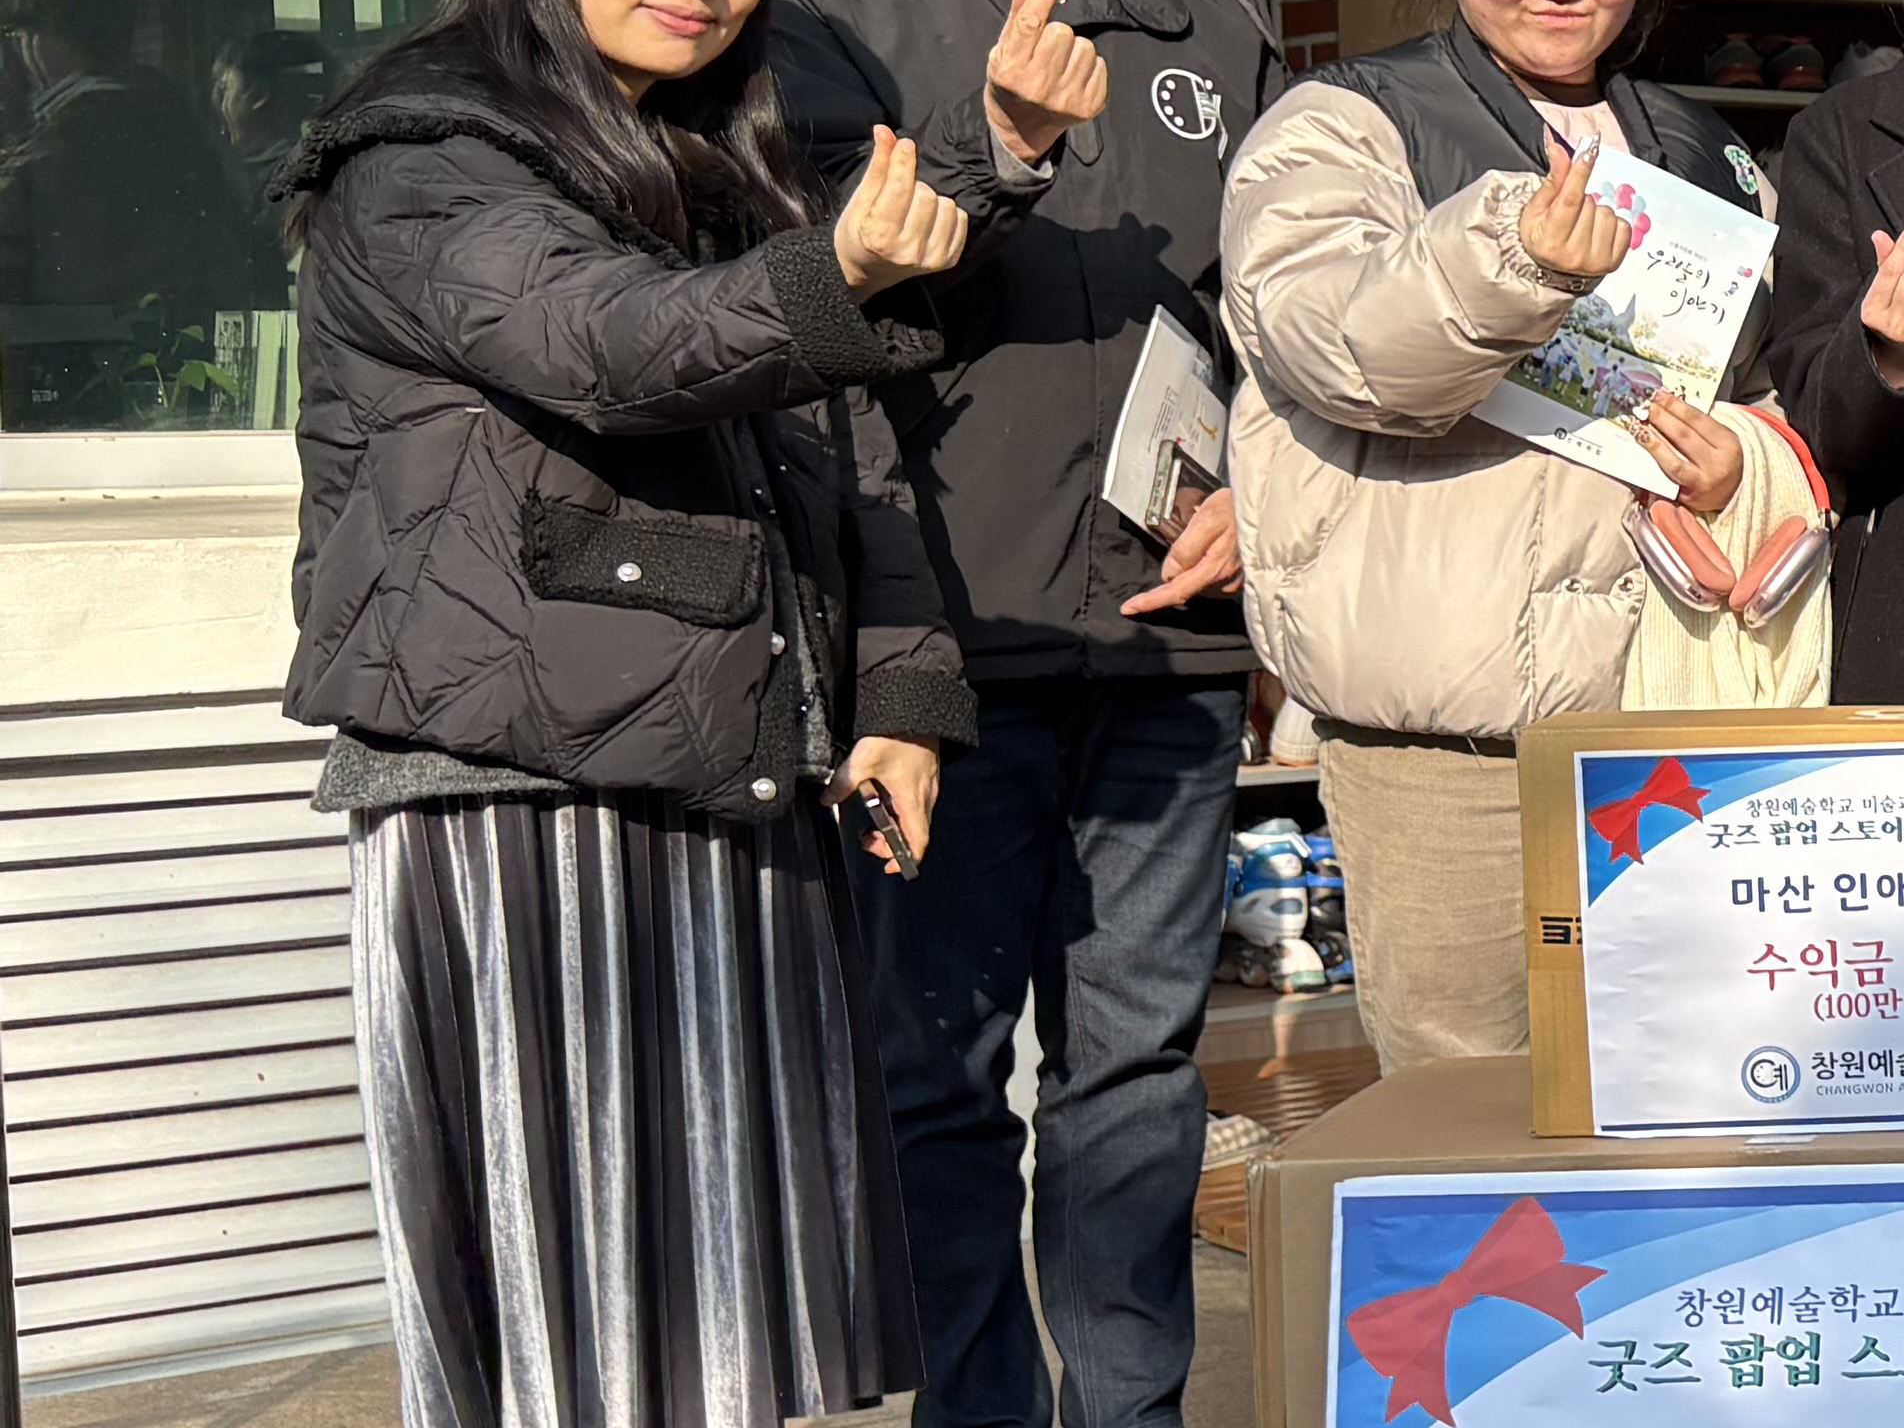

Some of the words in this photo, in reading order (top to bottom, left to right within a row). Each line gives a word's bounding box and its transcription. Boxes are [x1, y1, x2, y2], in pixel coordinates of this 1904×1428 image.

[1646, 250, 1710, 289] 우리들의
[1662, 287, 1726, 326] 이야기
[1747, 797, 1854, 818] 창원예술학교
[1707, 824, 1760, 848] 굿즈
[1770, 820, 1817, 846] 팝업
[1828, 817, 1902, 842] 스토어
[1732, 875, 1814, 913] 마산
[1747, 940, 1894, 991] 수익금
[1816, 1083, 1893, 1095] CHANGWON
[1676, 1284, 1904, 1327] 창원예술학교
[1588, 1340, 1701, 1393] 굿즈
[1720, 1331, 1820, 1388] 팝업
